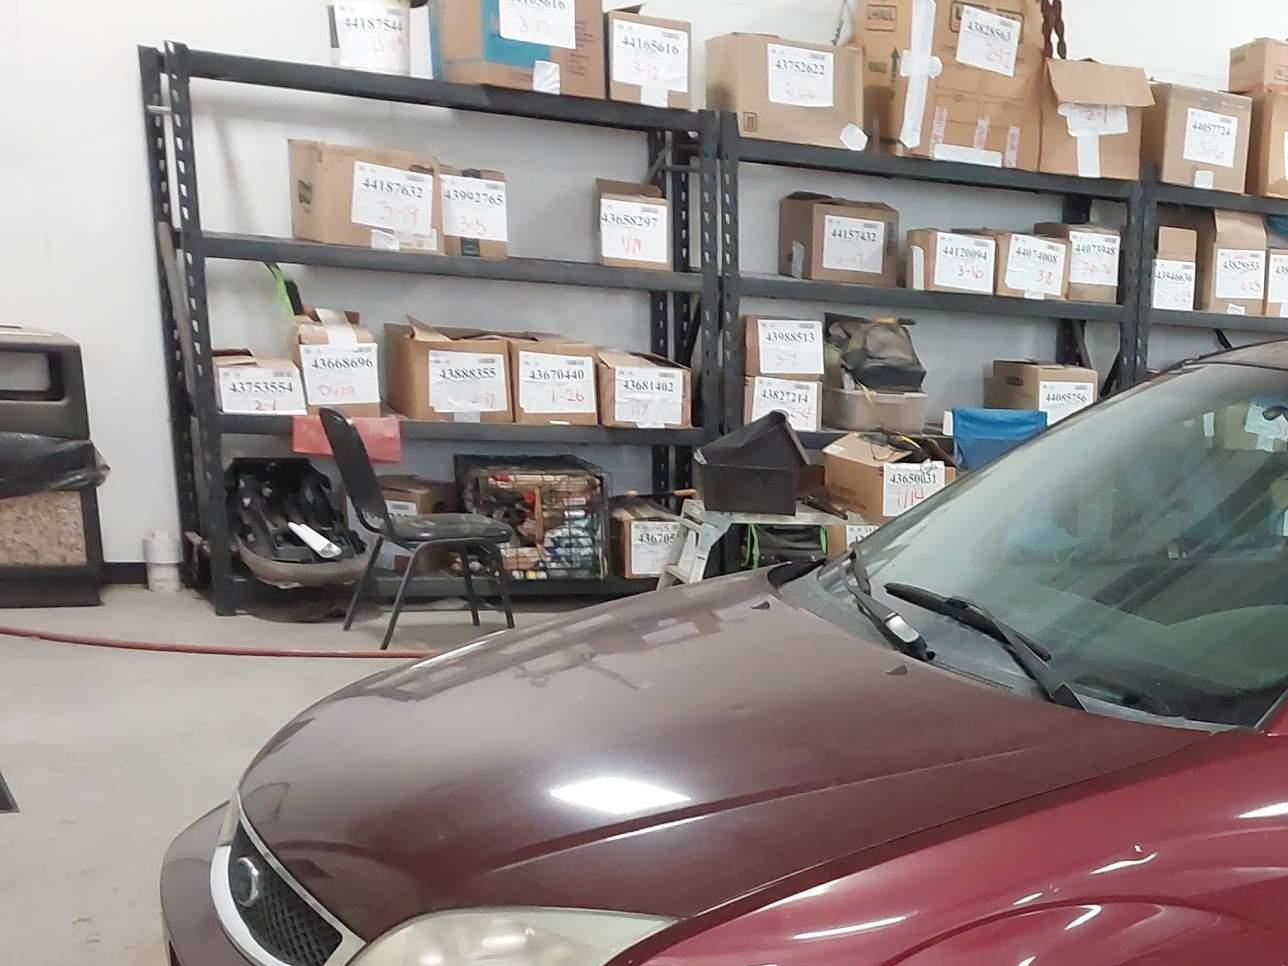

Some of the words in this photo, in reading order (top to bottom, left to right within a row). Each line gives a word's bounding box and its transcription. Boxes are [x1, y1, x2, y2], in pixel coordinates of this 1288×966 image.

[622, 37, 680, 55] 44165616
[360, 177, 425, 199] 44187632
[444, 188, 504, 207] 43992765
[765, 331, 816, 343] 43988513
[311, 355, 375, 370] 43668696
[529, 368, 586, 382] 43670440
[229, 381, 295, 395] 43753554
[889, 470, 938, 485] 43650031
